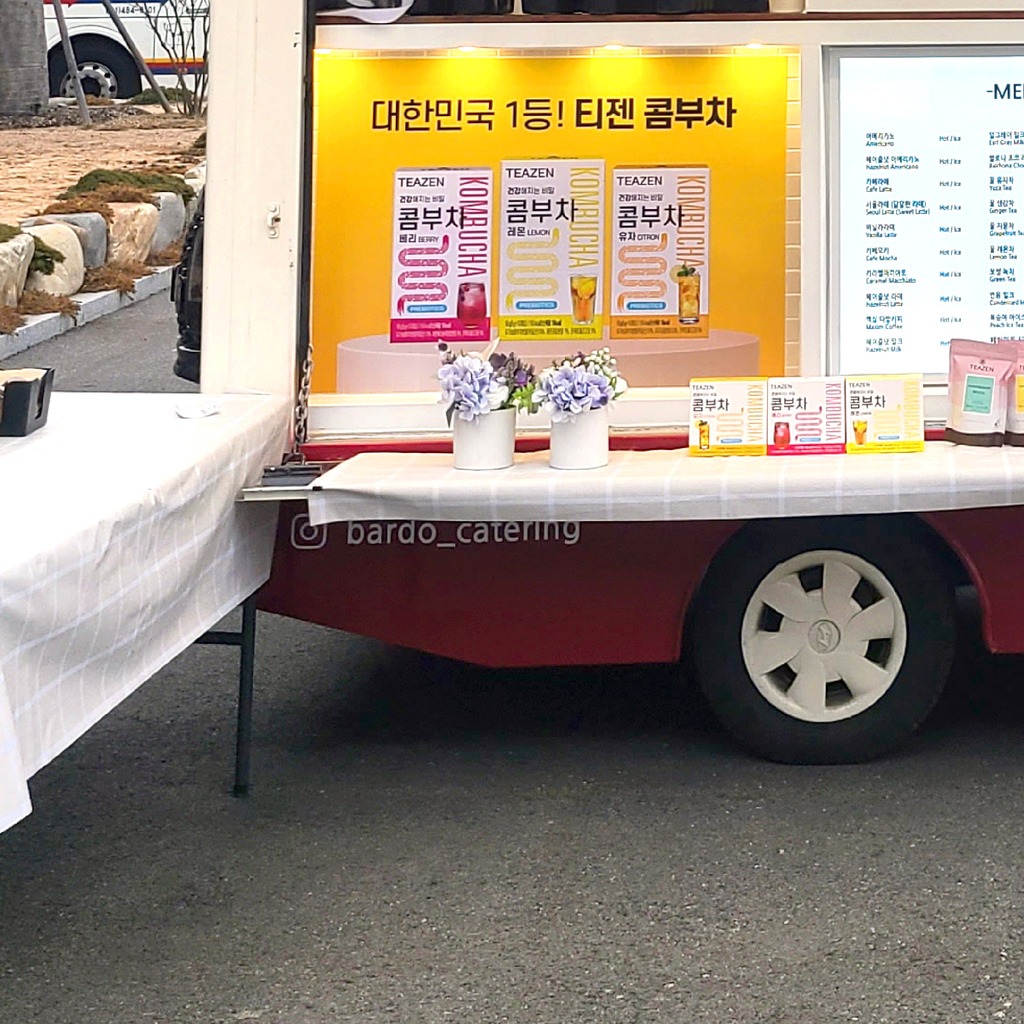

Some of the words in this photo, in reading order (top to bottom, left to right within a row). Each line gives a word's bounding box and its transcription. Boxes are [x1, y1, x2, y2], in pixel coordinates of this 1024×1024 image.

[371, 98, 495, 132] 대한민국
[506, 98, 564, 131] 1등!
[575, 97, 635, 130] 티젠
[643, 96, 737, 130] 콤부차
[505, 168, 554, 178] TEAZEN
[398, 177, 445, 187] TEAZEN
[617, 176, 663, 186] TEAZEN
[398, 206, 468, 231] 콤부차
[506, 198, 579, 224] 콤부차
[569, 167, 600, 269] KOMBUCHA
[617, 205, 686, 229] 콤부차
[457, 176, 489, 278] KOMBUCHA
[676, 176, 705, 268] KOMBUCHA
[399, 234, 417, 243] 베리
[507, 227, 526, 237] 레몬
[618, 232, 636, 242] 유자
[970, 364, 995, 373] TEAZEN
[692, 398, 729, 412] 콤부차
[771, 397, 807, 411] 콤부차
[849, 394, 886, 409] 콤부차
[826, 383, 842, 441] KOMBUCHA
[347, 520, 581, 548] bardo_catering
